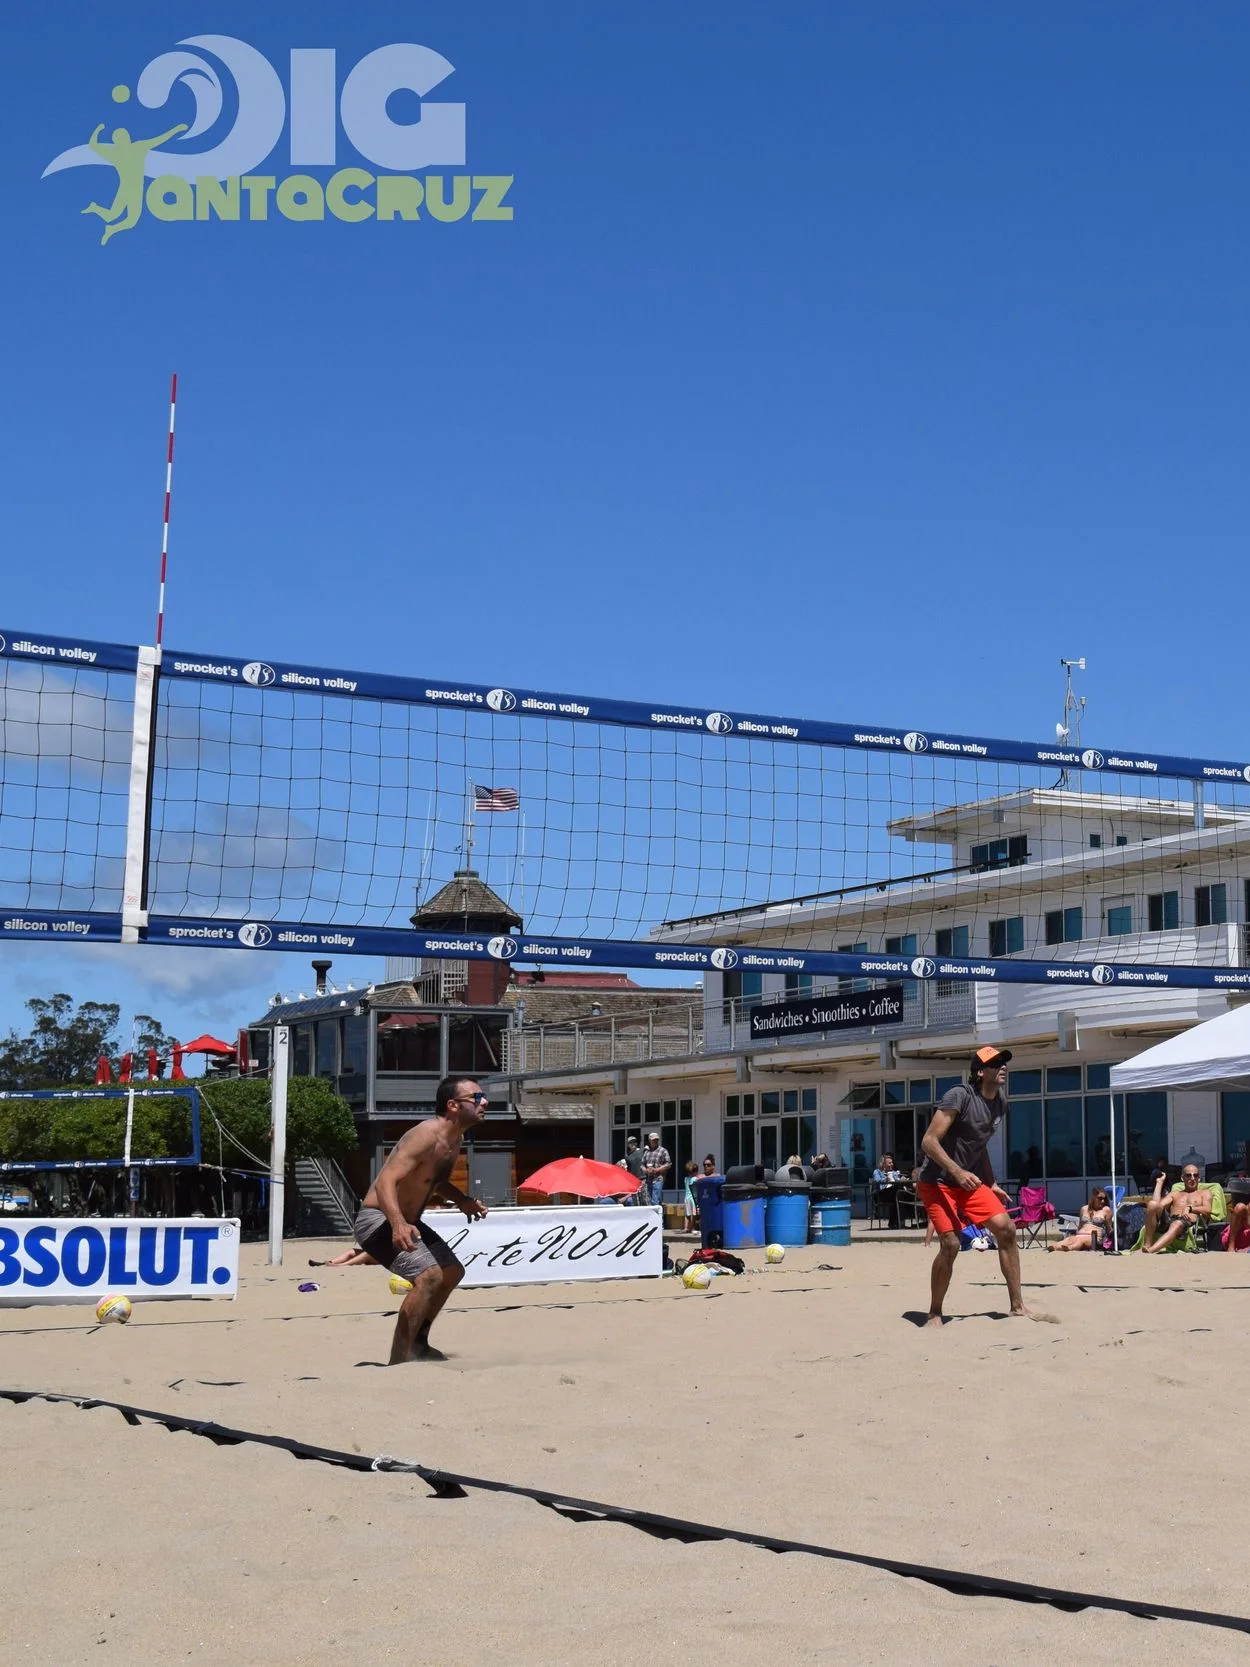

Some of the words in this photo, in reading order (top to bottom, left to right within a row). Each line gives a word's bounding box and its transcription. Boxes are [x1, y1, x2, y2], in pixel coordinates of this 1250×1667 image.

[11, 640, 56, 656] silicon
[58, 647, 97, 663] volley
[173, 661, 239, 677] sprocket's
[281, 672, 321, 686] silicon
[322, 677, 358, 692] volley
[425, 689, 484, 703] sprocket's
[521, 698, 557, 711] silicon
[558, 703, 590, 716] volley
[650, 713, 703, 726] sprocket's
[737, 721, 769, 733] silicon
[770, 725, 799, 738] volley
[854, 733, 902, 746] sprocket's
[931, 740, 961, 751] silicon
[962, 743, 988, 755] volley
[1037, 751, 1080, 763] sprocket's
[1107, 757, 1134, 768] silicon
[1134, 760, 1158, 771] volley
[1202, 767, 1242, 777] sprocket's
[3, 918, 48, 931] silicon
[51, 920, 91, 935] volley
[168, 926, 234, 939] sprocket's
[277, 931, 318, 943] silicon
[320, 933, 356, 947] volley
[425, 940, 484, 952] sprocket's
[522, 943, 559, 955] silicon
[560, 946, 593, 959] volley
[655, 951, 708, 963] sprocket's
[742, 954, 775, 966] silicon
[776, 957, 805, 969] volley
[861, 961, 909, 972] sprocket's
[939, 963, 969, 974] silicon
[970, 965, 996, 977] volley
[1046, 969, 1090, 979] sprocket's
[1117, 970, 1144, 980] silicon
[1145, 971, 1169, 983] volley
[753, 1010, 804, 1031] Sandwiches
[868, 996, 900, 1017] Coffee
[279, 1031, 288, 1045] 2
